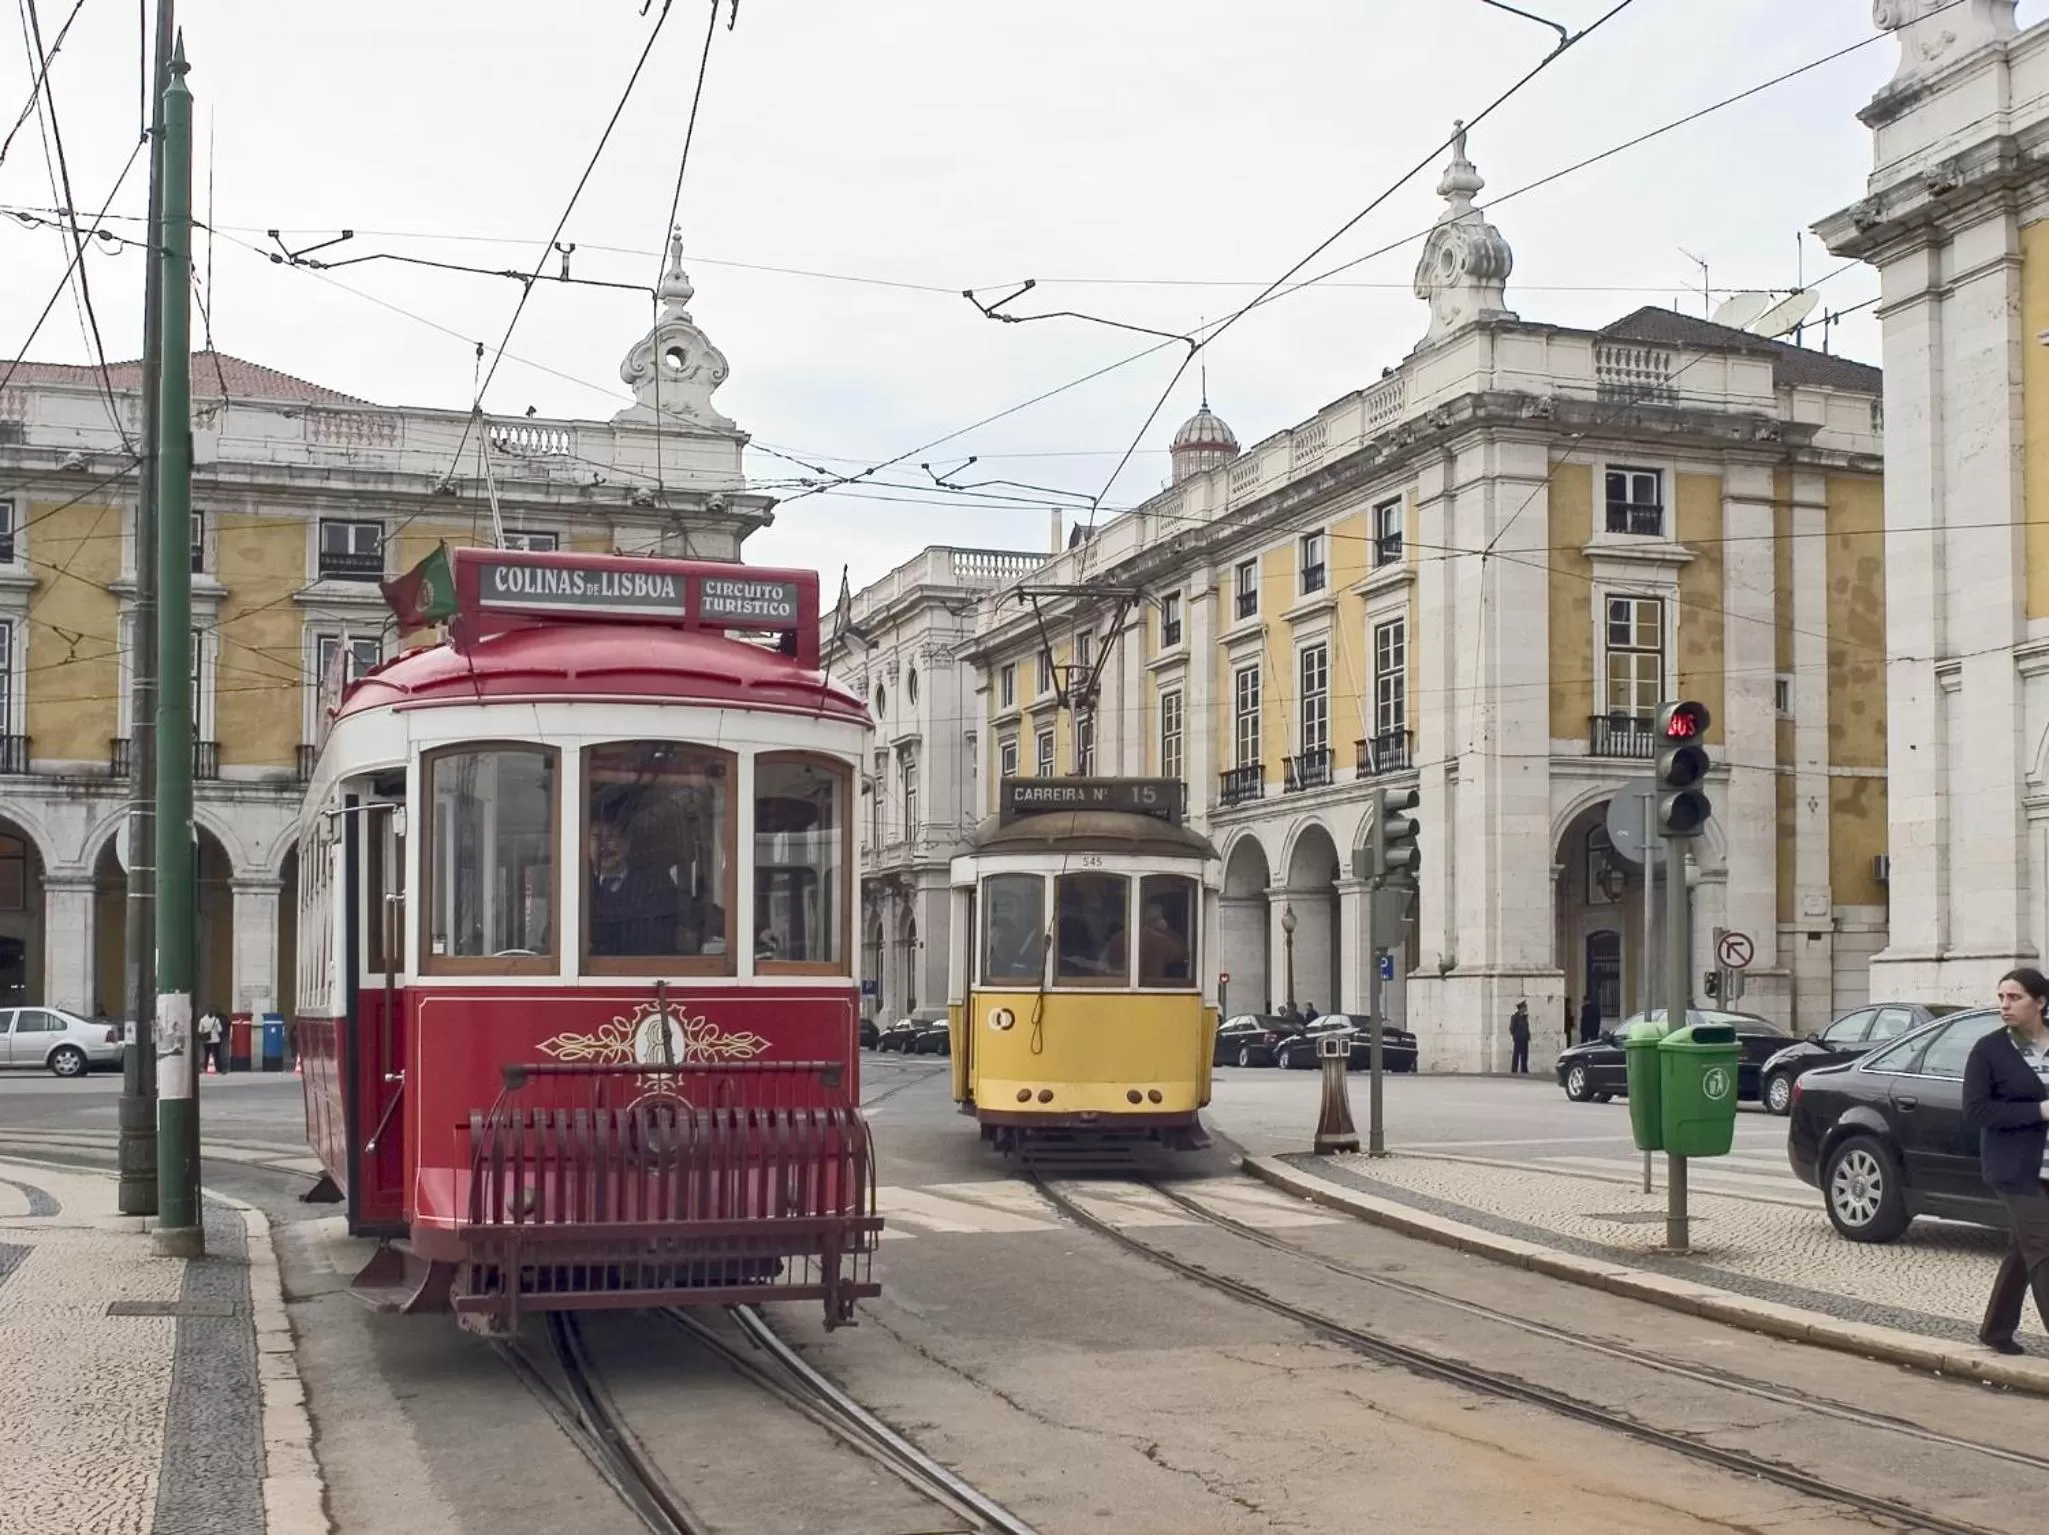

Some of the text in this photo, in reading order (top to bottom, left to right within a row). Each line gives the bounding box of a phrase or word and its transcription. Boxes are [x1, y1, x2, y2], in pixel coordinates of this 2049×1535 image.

[495, 566, 675, 598] COLINAS DE LISBOA
[705, 581, 784, 600] CIRCUITO
[1014, 787, 1085, 801] CARREIRA
[1131, 786, 1157, 804] 15
[1082, 856, 1103, 868] 545
